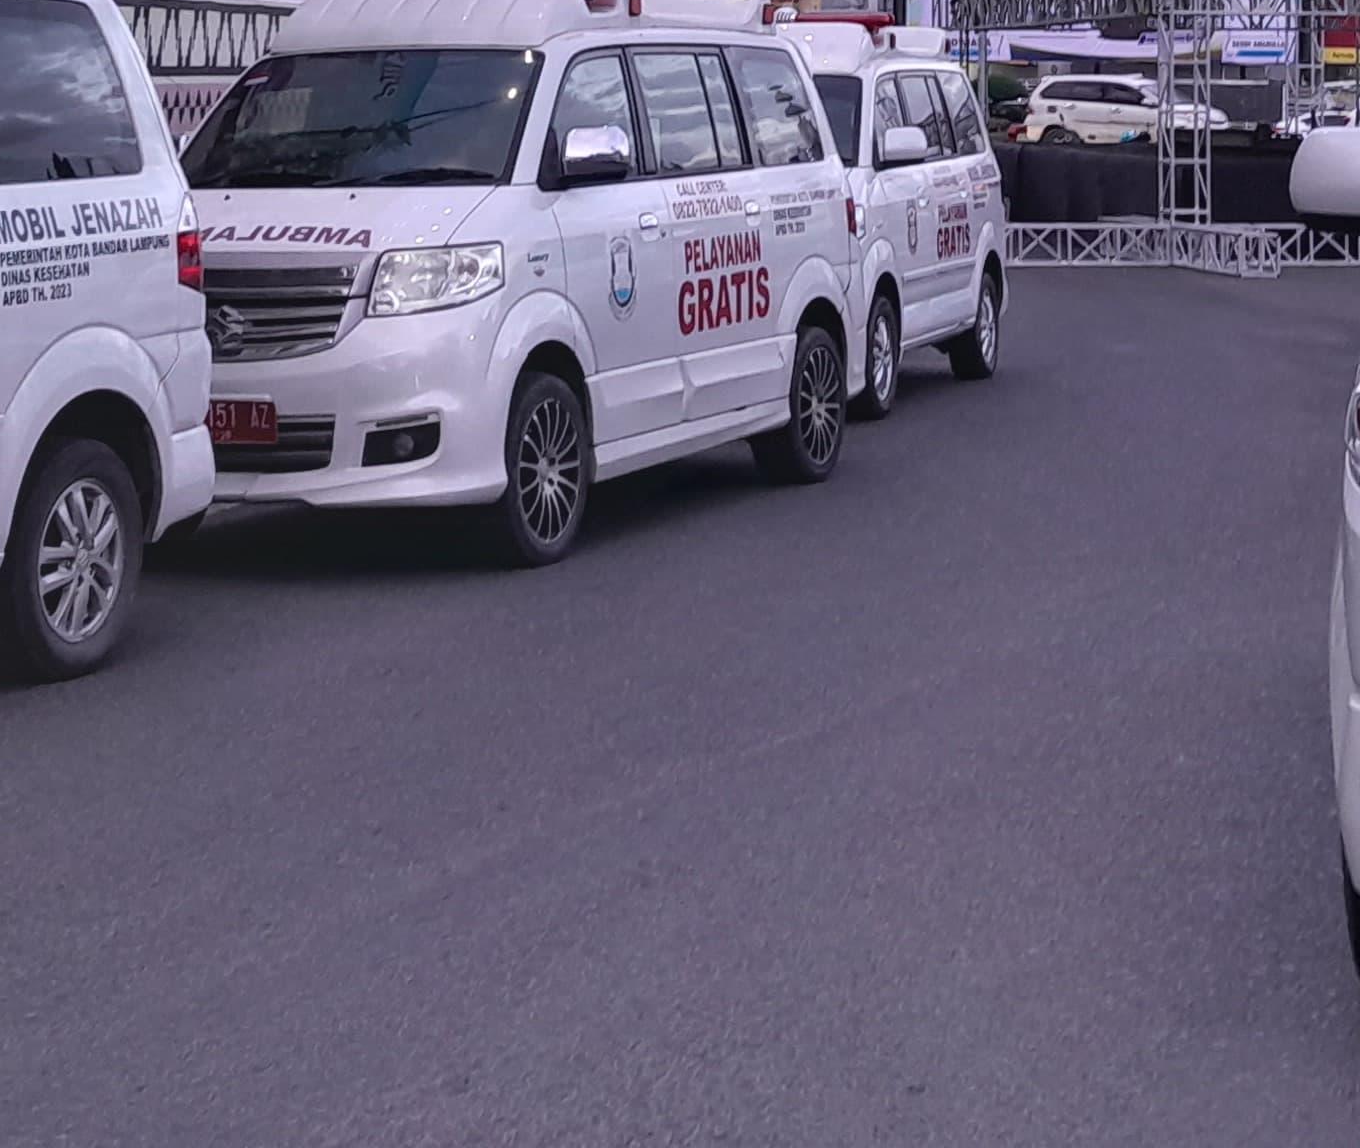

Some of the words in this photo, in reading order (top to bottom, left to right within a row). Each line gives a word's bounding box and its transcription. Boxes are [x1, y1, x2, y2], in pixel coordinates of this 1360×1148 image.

[71, 196, 164, 237] JENAZAH
[0, 245, 63, 268] PEMERINTAH
[64, 243, 92, 259] KOTA
[92, 238, 129, 257] BANDAR
[129, 233, 171, 253] LAMPUNG
[684, 229, 762, 275] PELAYANAN
[937, 222, 971, 261] GRATIS
[0, 266, 32, 288] DINAS
[33, 260, 91, 283] KESEHATAN
[678, 266, 771, 337] GRATIS
[250, 402, 271, 429] AZ
